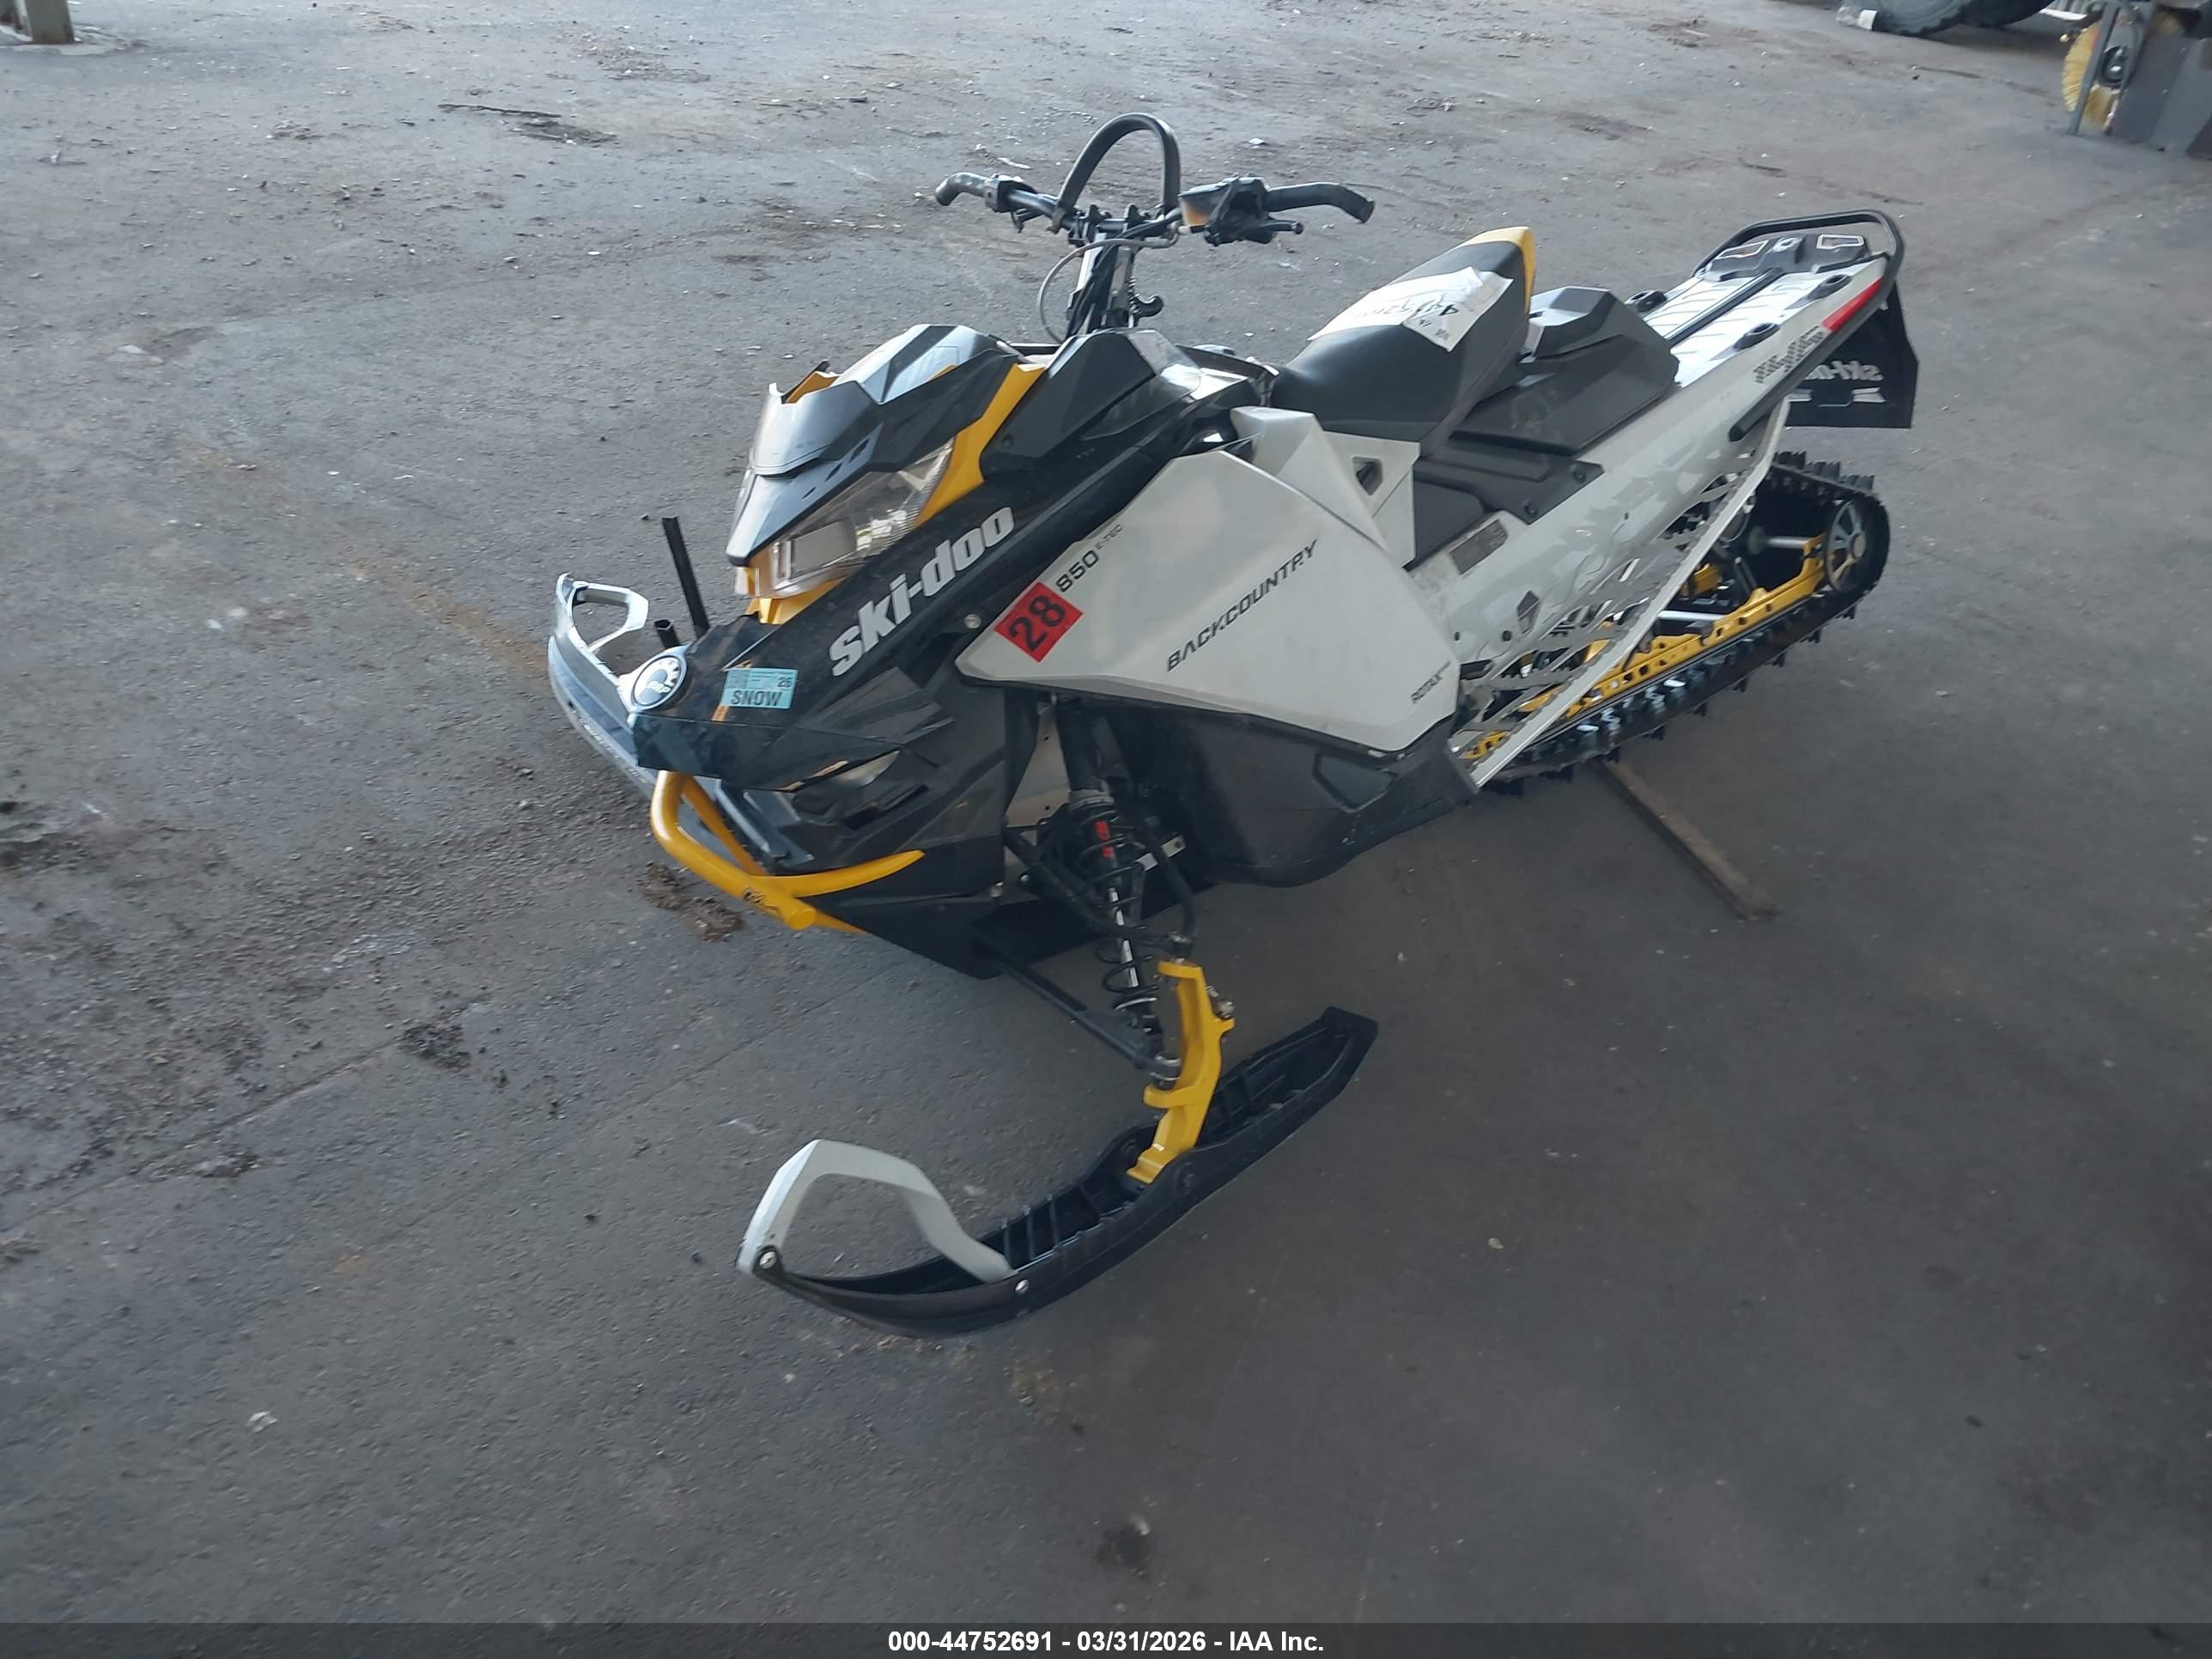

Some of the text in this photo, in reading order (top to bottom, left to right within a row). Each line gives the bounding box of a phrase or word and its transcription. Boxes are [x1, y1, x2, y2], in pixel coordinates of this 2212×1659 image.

[829, 507, 1016, 677] ski-doo
[1055, 550, 1099, 593] 850
[1009, 595, 1066, 652] 28
[1166, 538, 1318, 672] BACKCOUNTRY
[647, 680, 672, 694] BRP
[731, 690, 782, 707] SNOW
